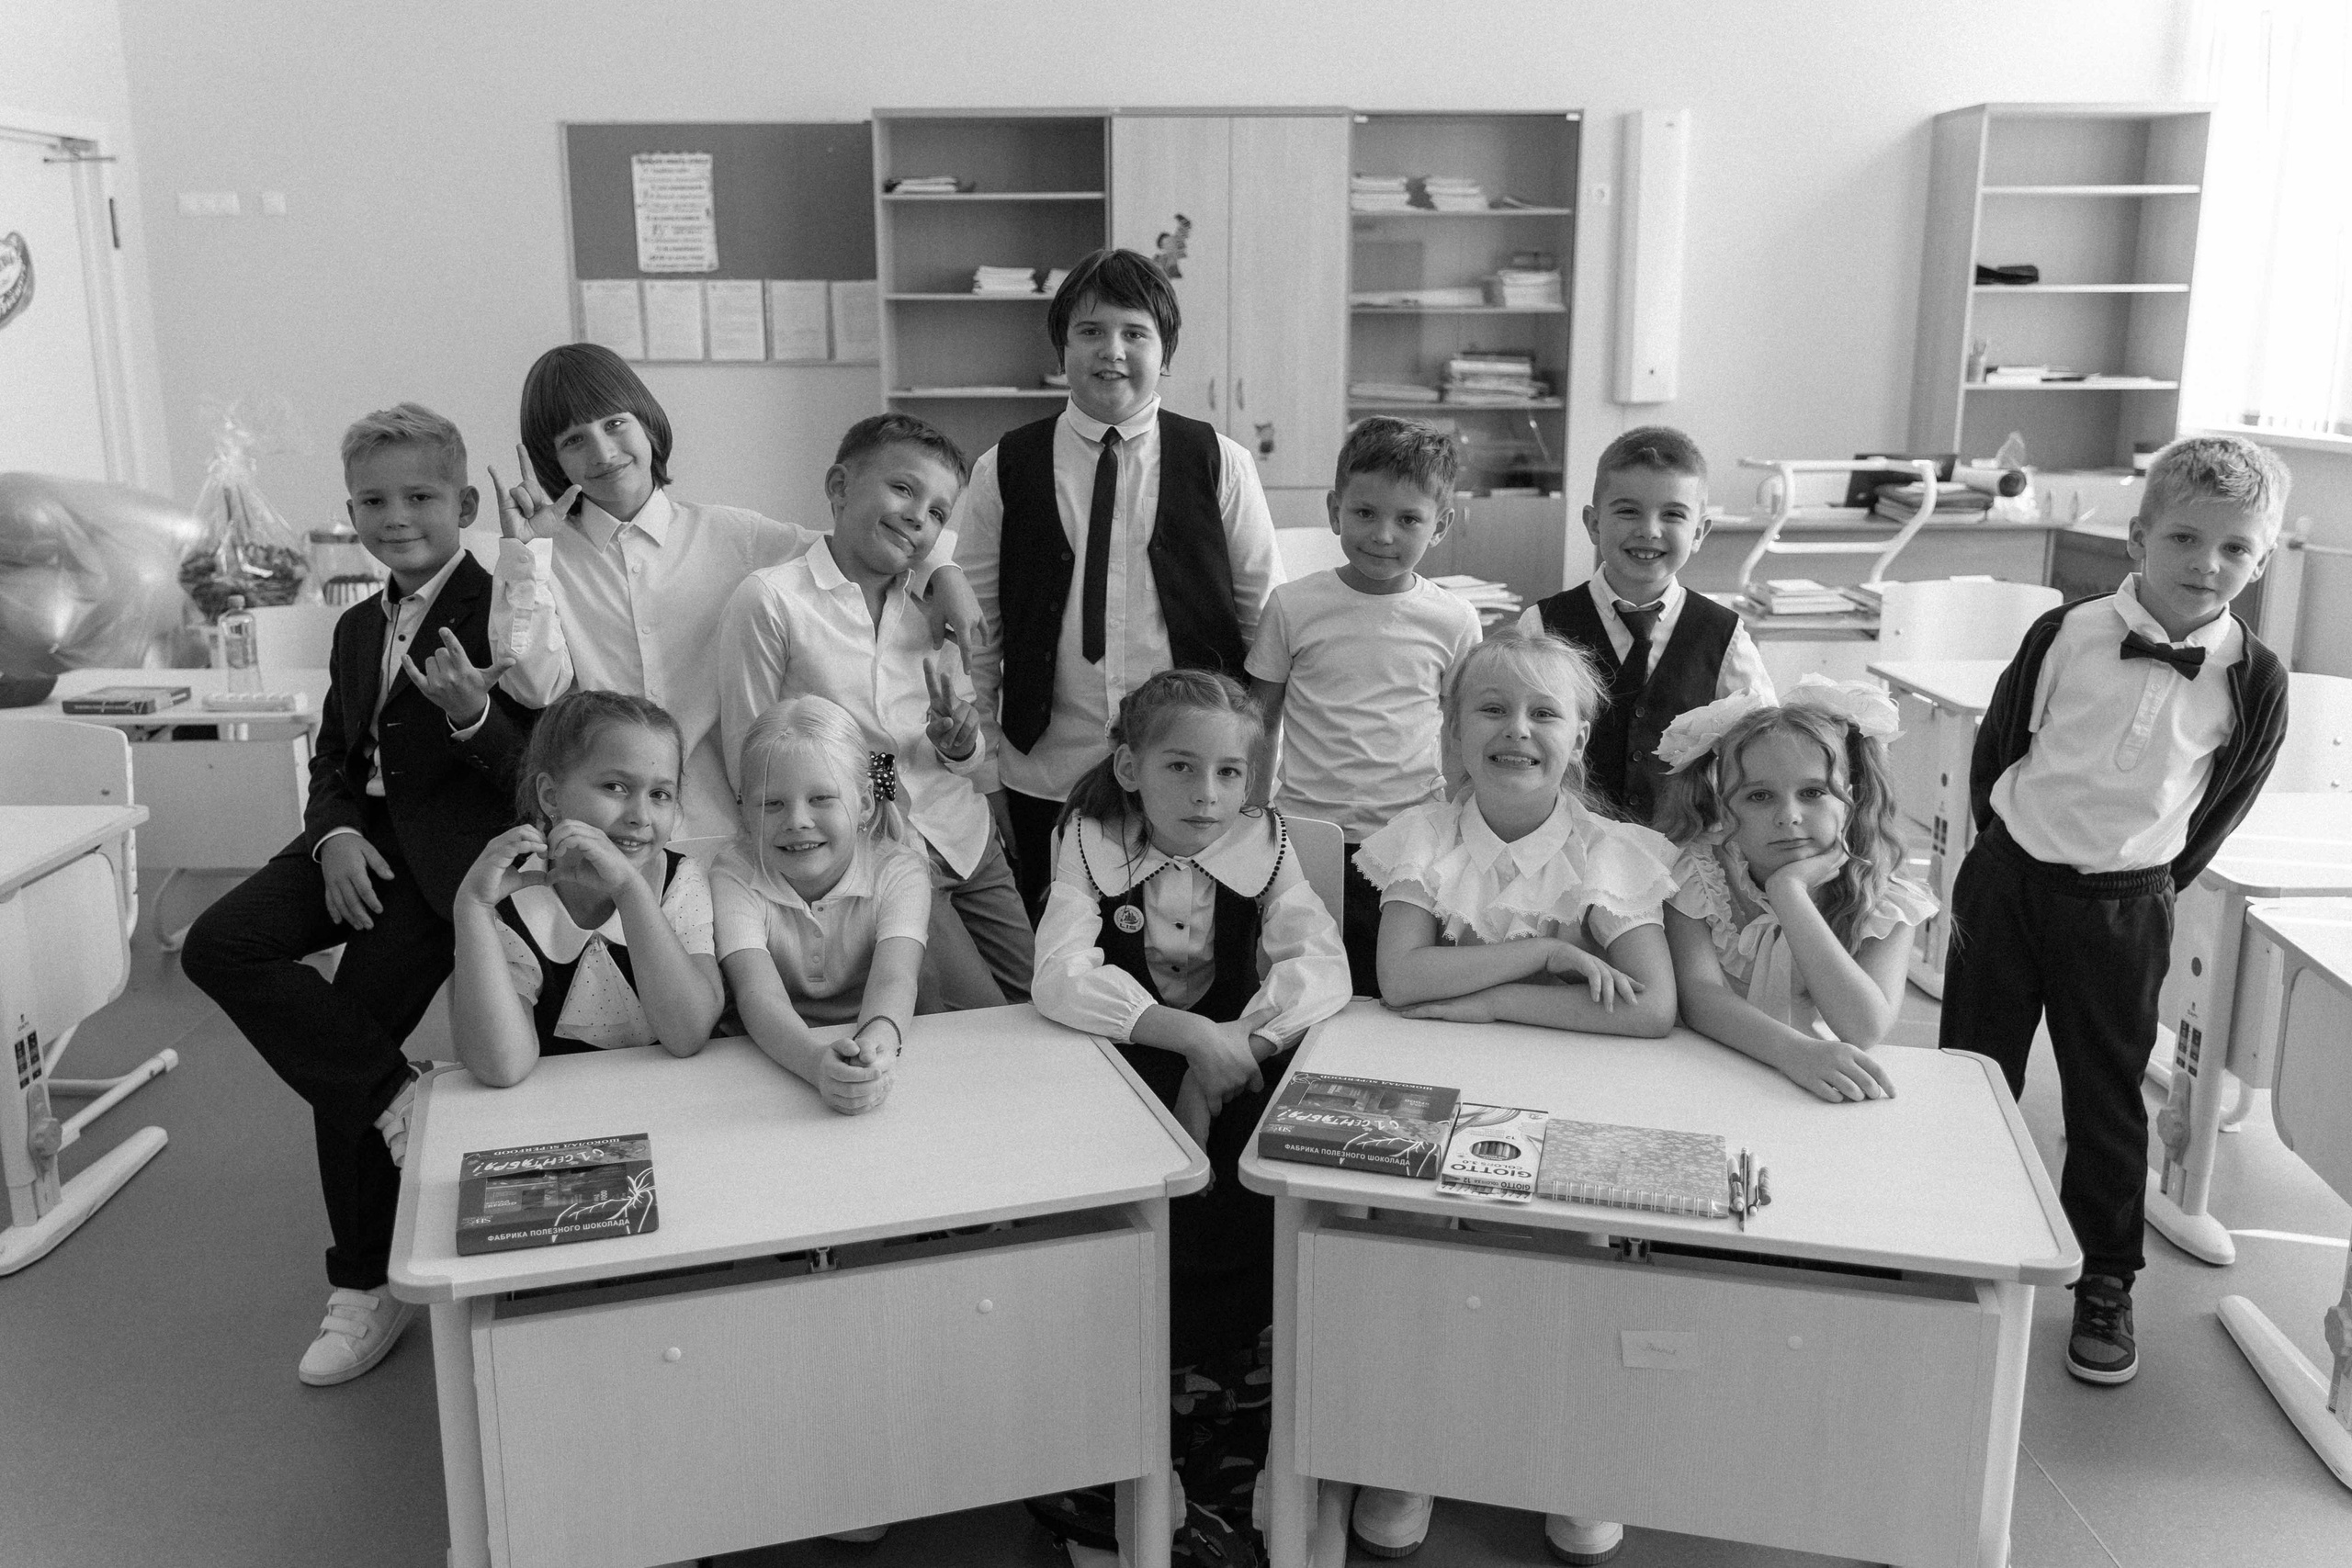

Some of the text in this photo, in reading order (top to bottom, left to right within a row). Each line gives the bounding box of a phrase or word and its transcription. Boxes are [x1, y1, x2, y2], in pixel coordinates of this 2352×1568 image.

[1277, 1110, 1371, 1127] СЕНТЯБРЯ!
[1284, 1143, 1411, 1167] ФАБРИКА ПОЛЕЗНОГО ШОКОЛАДА
[1450, 1163, 1532, 1179] GIOTTO
[1500, 1181, 1531, 1190] GIOTTO
[487, 1218, 630, 1243] ФАБРИКА ПОЛЕЗНОГО ШОКОЛАДА
